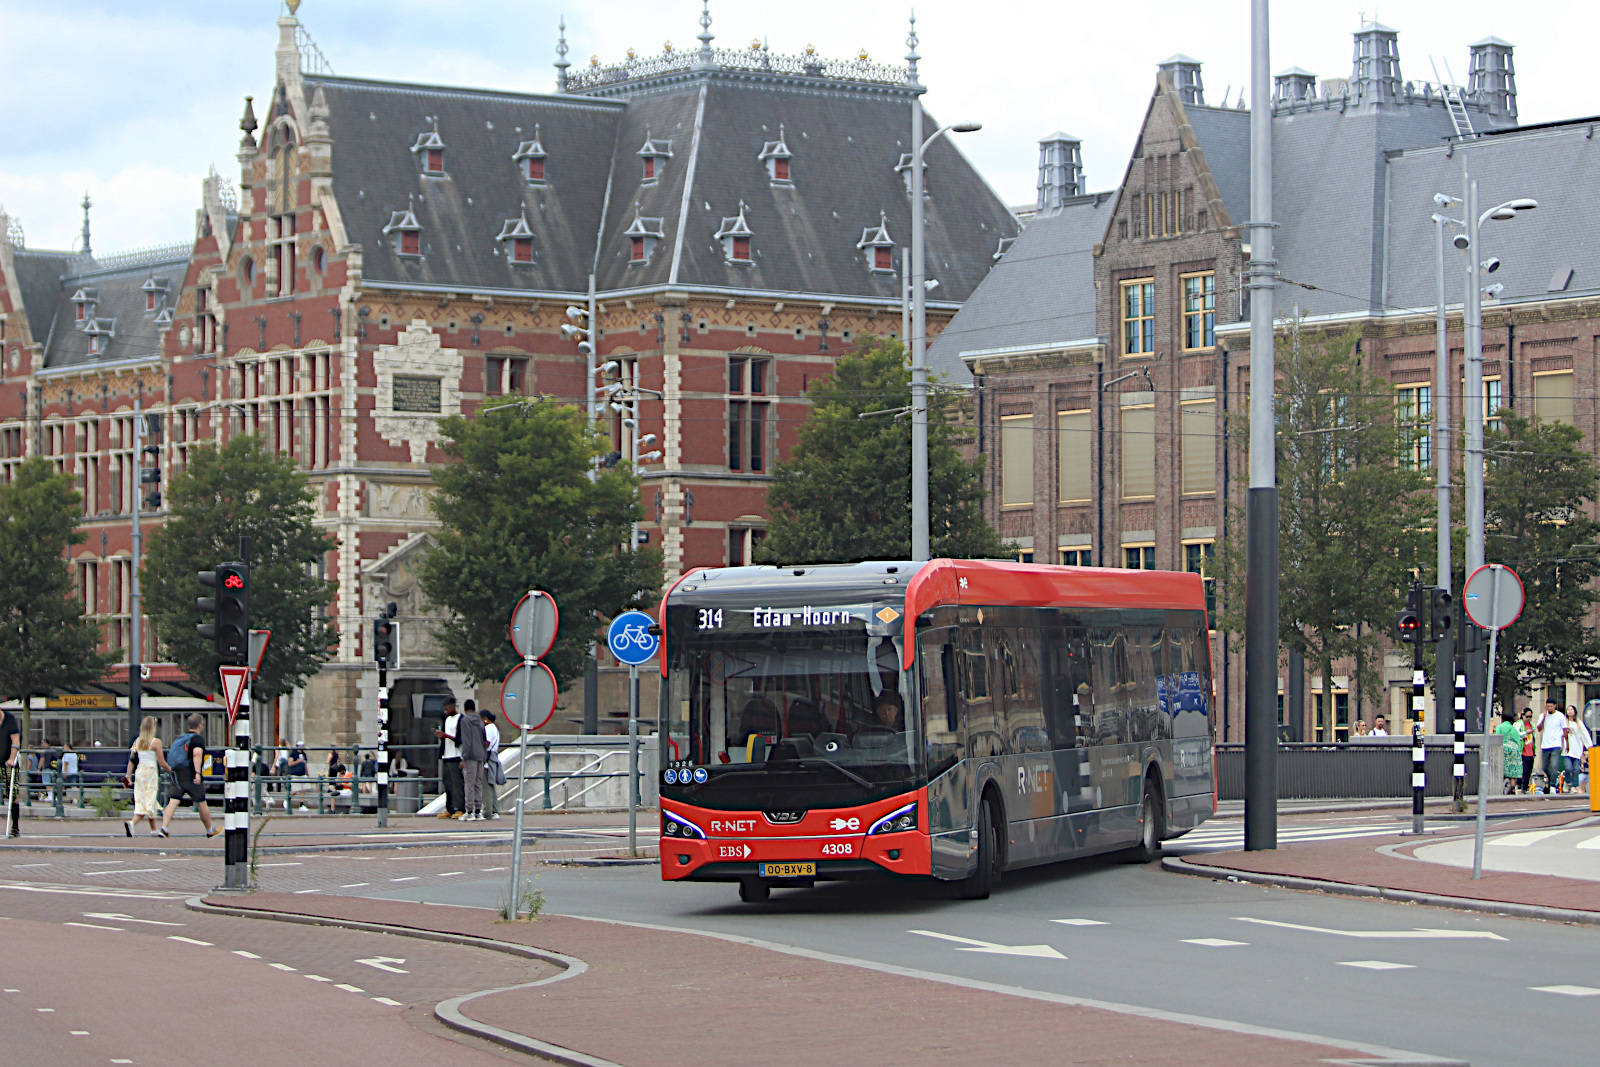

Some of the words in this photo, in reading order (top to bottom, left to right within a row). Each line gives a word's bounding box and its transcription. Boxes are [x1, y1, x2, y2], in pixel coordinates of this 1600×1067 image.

[698, 608, 723, 629] 314
[753, 605, 850, 627] Edam-Hoorn
[770, 812, 799, 821] VDL
[719, 846, 743, 857] EBS
[821, 843, 853, 855] 4308
[767, 864, 812, 875] 00-BXV-8
